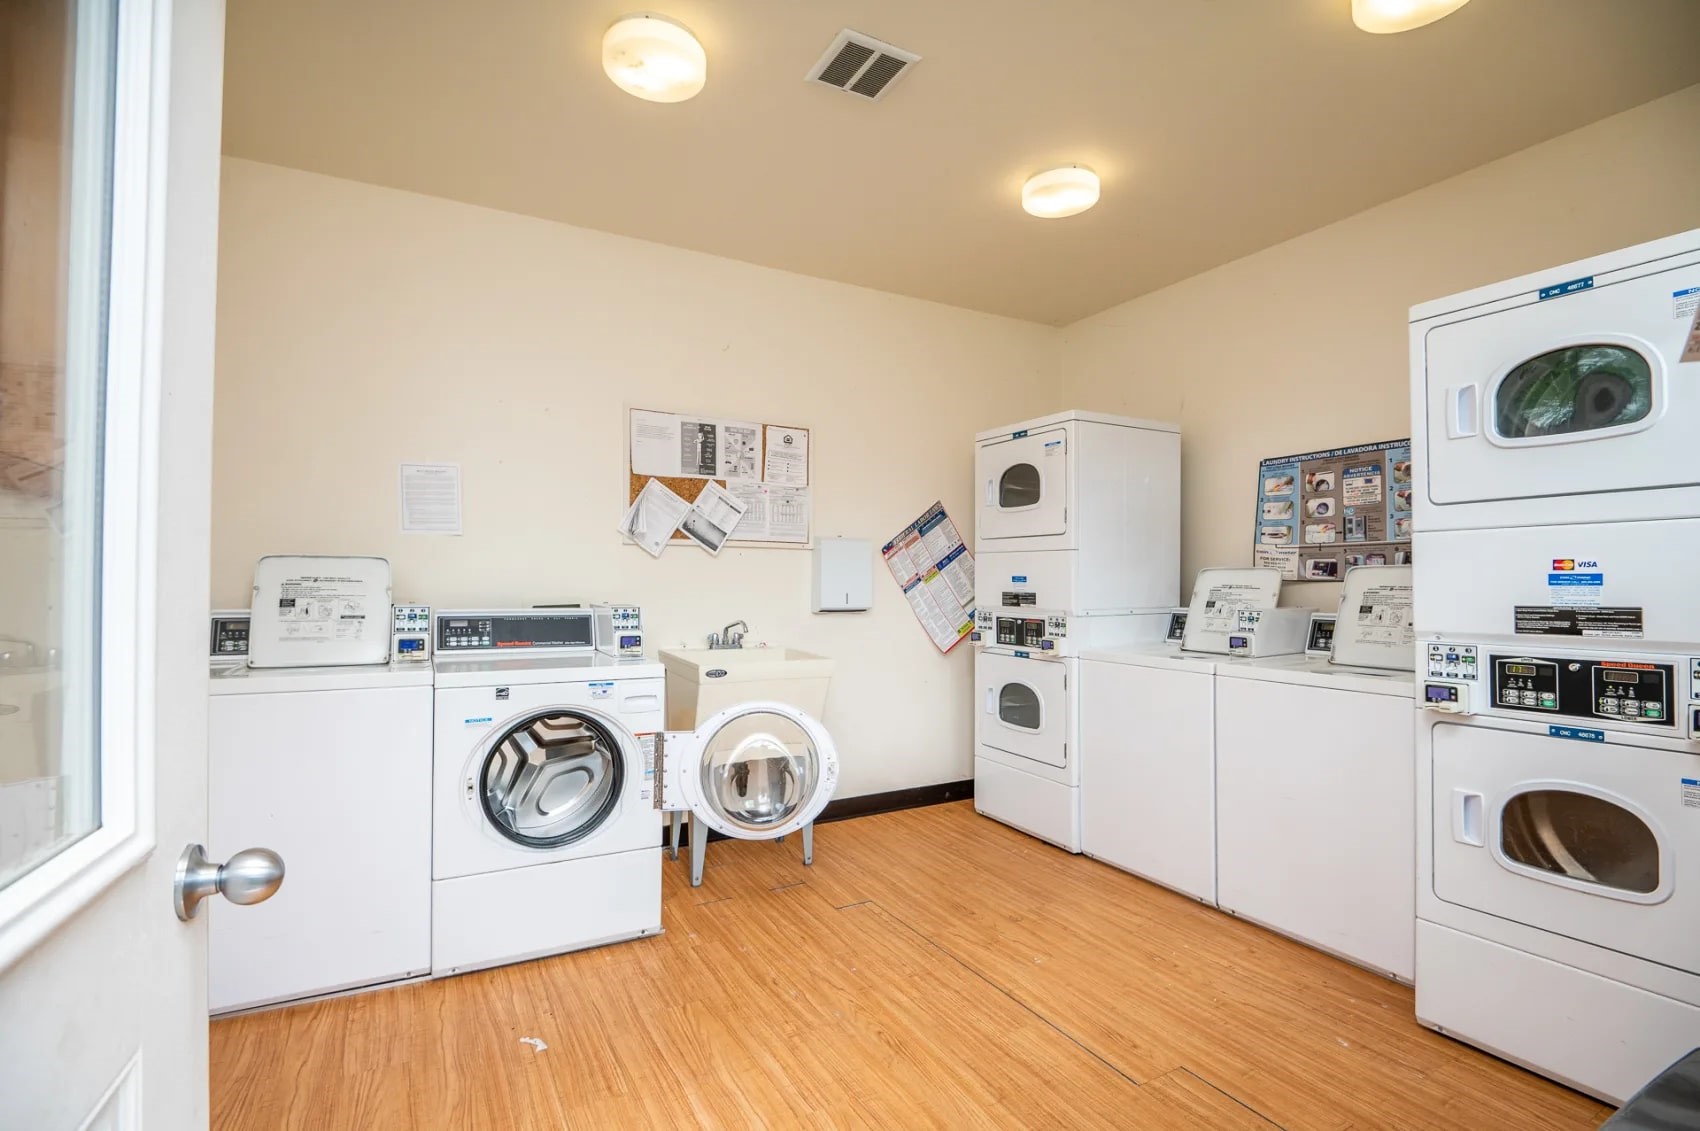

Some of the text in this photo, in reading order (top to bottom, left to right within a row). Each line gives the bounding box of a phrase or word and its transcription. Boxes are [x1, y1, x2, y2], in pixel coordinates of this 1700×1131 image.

[1262, 458, 1289, 466] LAUNDRY
[1289, 452, 1330, 463] INSTRUCTIONS
[1344, 445, 1377, 455] LAVADORA
